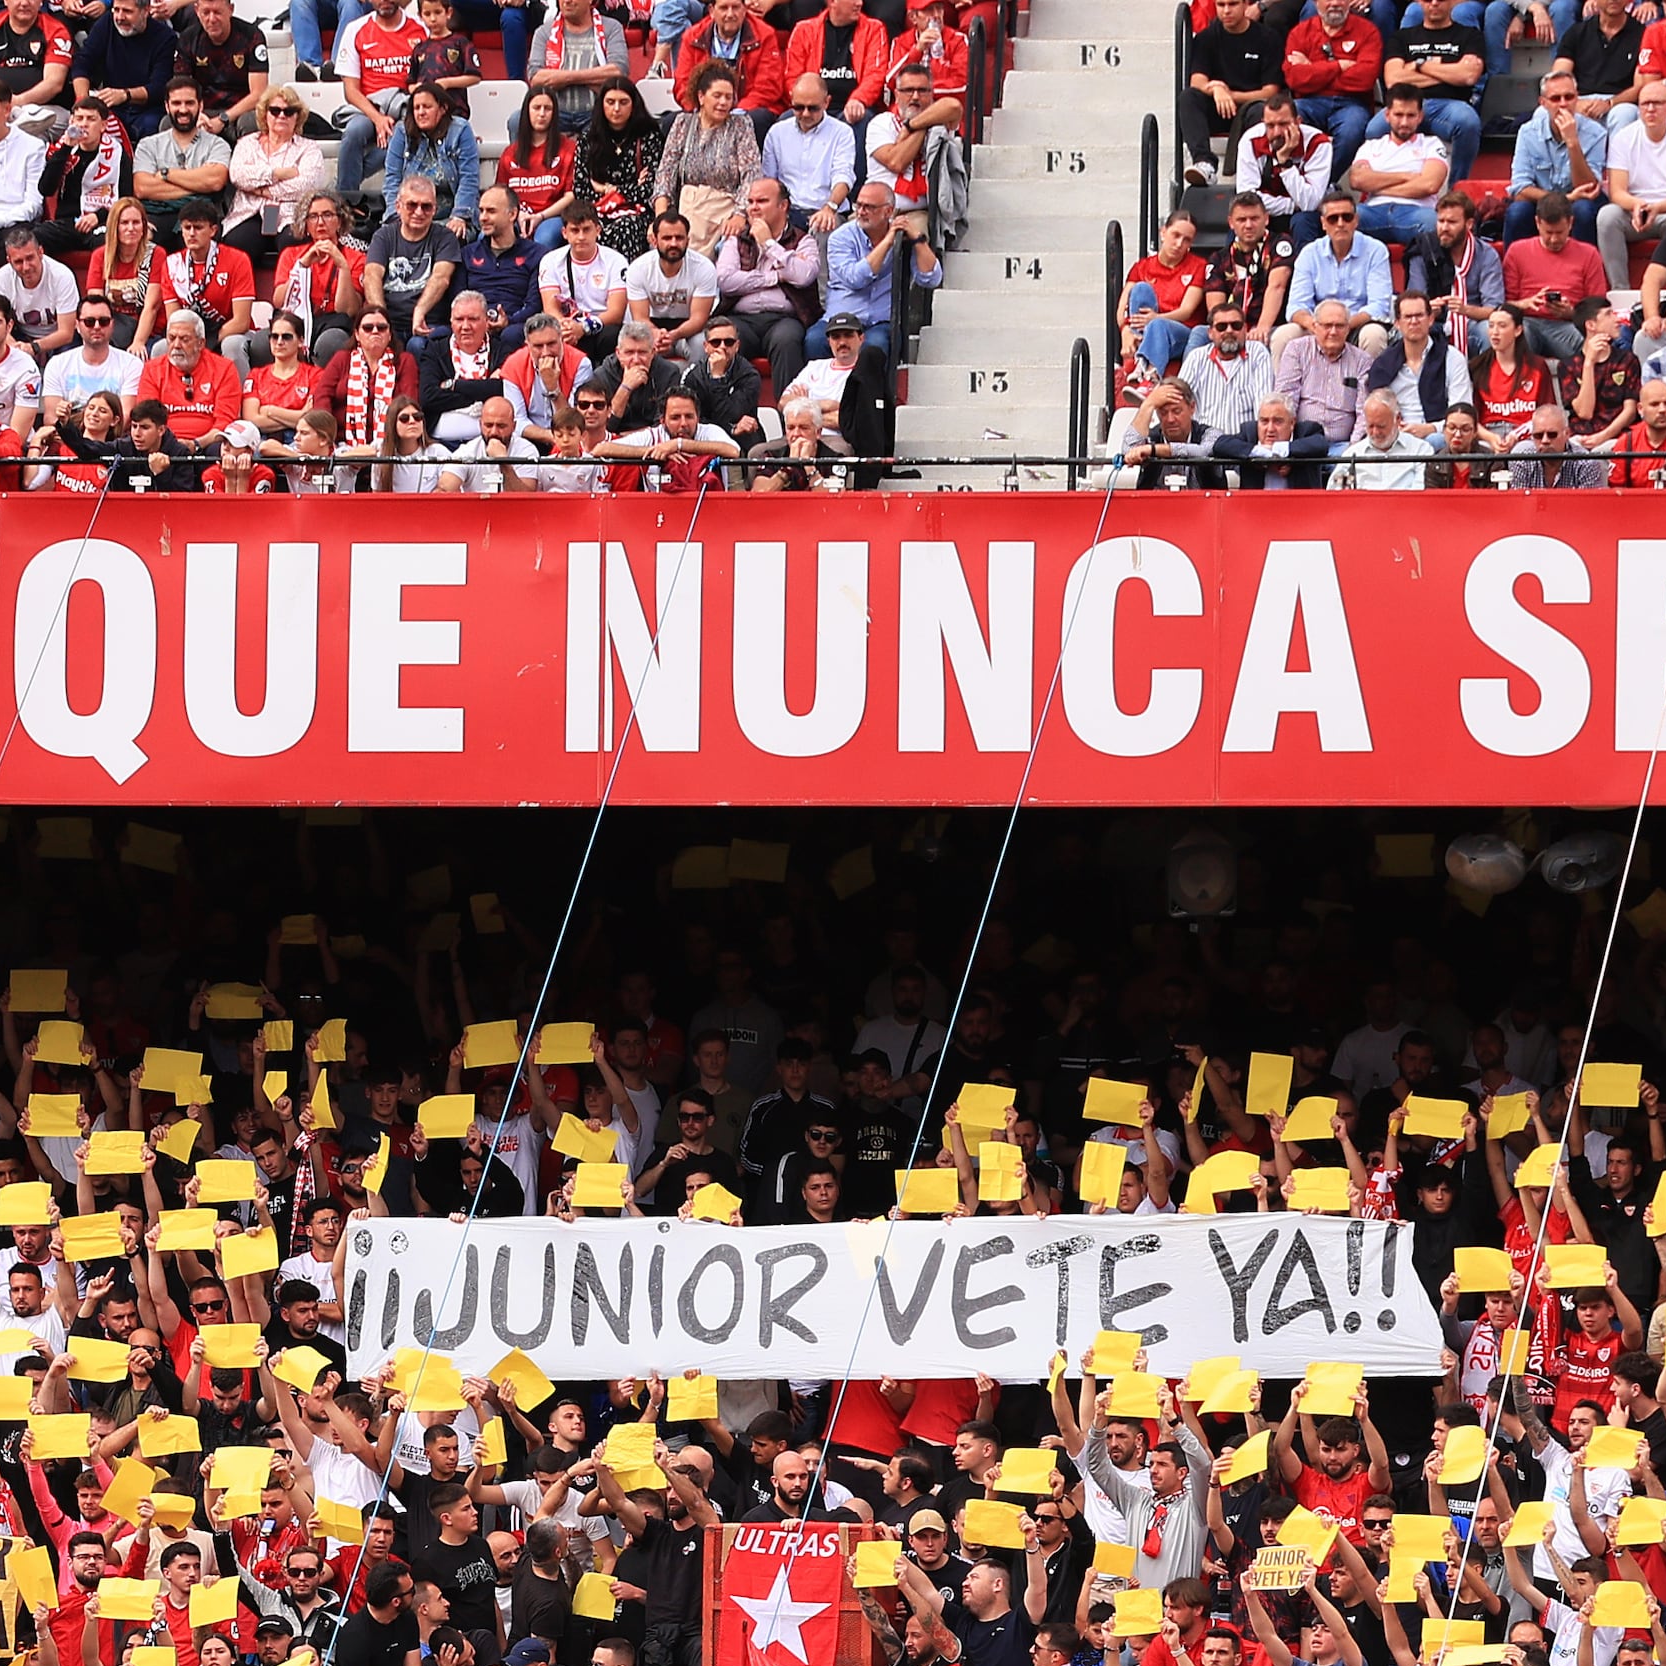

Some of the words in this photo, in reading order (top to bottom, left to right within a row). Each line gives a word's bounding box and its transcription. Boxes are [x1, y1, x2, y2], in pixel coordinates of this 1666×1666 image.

[364, 56, 411, 68] MARATHO
[1080, 45, 1097, 66] F
[1105, 46, 1121, 67] 6
[1046, 151, 1063, 173] F
[1070, 152, 1085, 174] 5
[520, 175, 560, 187] DEGIRO
[1005, 257, 1021, 279] F
[1026, 258, 1042, 279] 4
[970, 371, 986, 393] F
[993, 371, 1009, 393] 3
[56, 470, 101, 493] Playtik
[15, 539, 466, 785] QUE
[566, 541, 1372, 756] NUNCA
[871, 1234, 1172, 1350] VETE
[1208, 1219, 1405, 1343] YA!!
[734, 1526, 840, 1558] ULTRAS
[1256, 1548, 1306, 1568] JUNIOR
[1252, 1570, 1284, 1587] VETE
